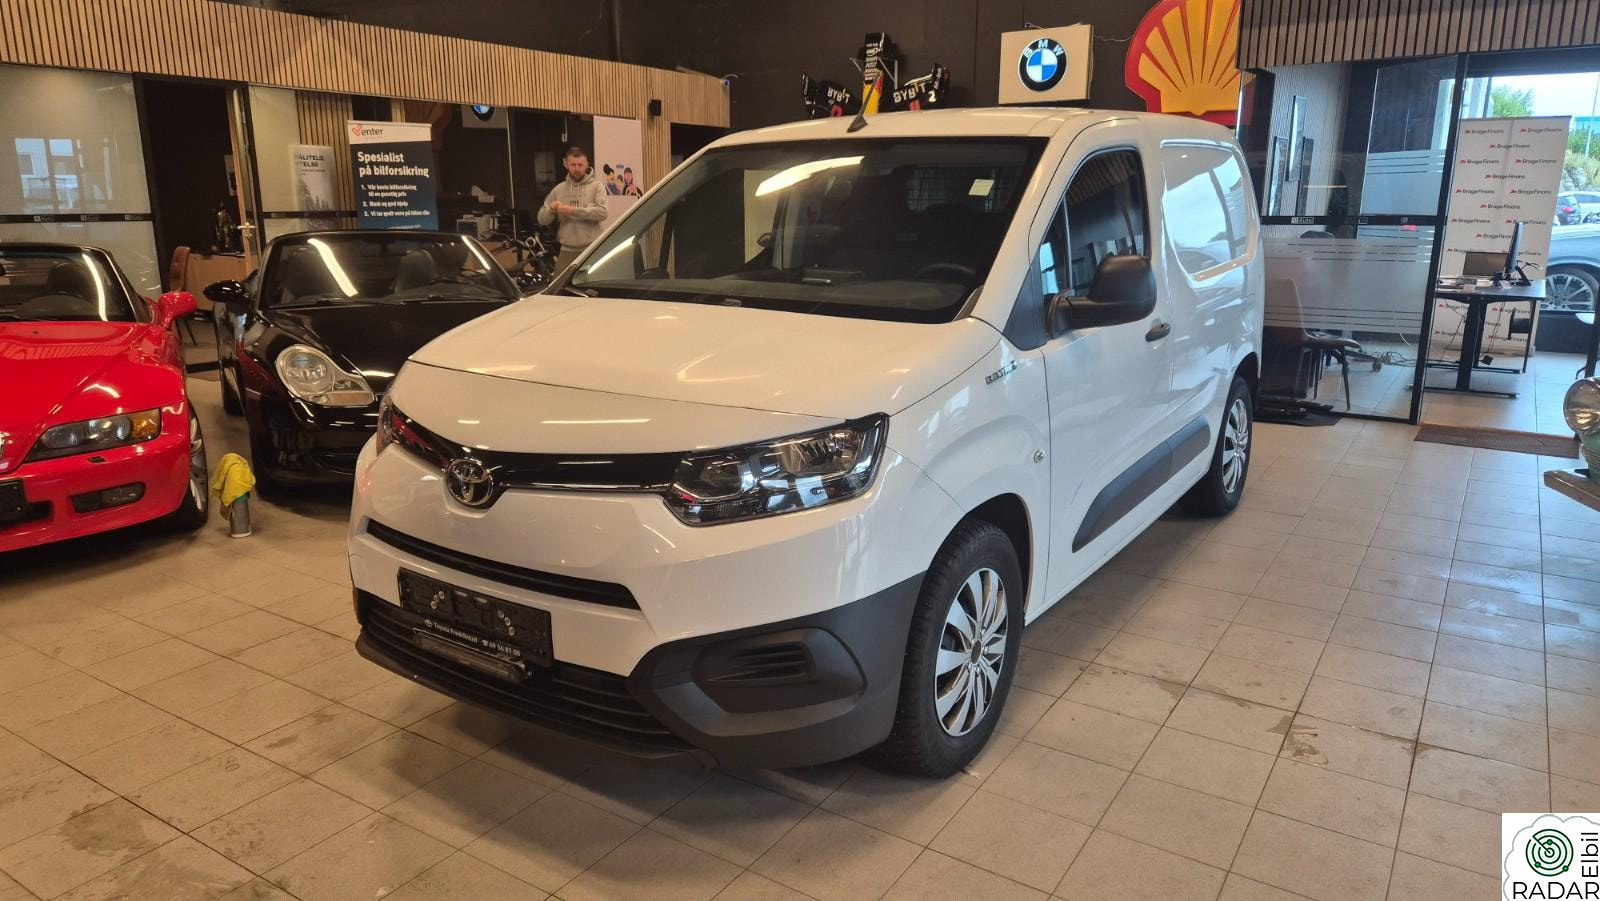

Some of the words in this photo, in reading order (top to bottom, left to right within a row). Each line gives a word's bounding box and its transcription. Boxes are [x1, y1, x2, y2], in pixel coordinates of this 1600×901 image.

[1024, 39, 1064, 58] BMW
[893, 82, 926, 104] BYBIT
[928, 90, 937, 103] 2
[357, 151, 404, 164] Spesialist
[359, 165, 372, 178] på
[373, 166, 430, 178] bilforsikring
[433, 622, 450, 633] Toyota
